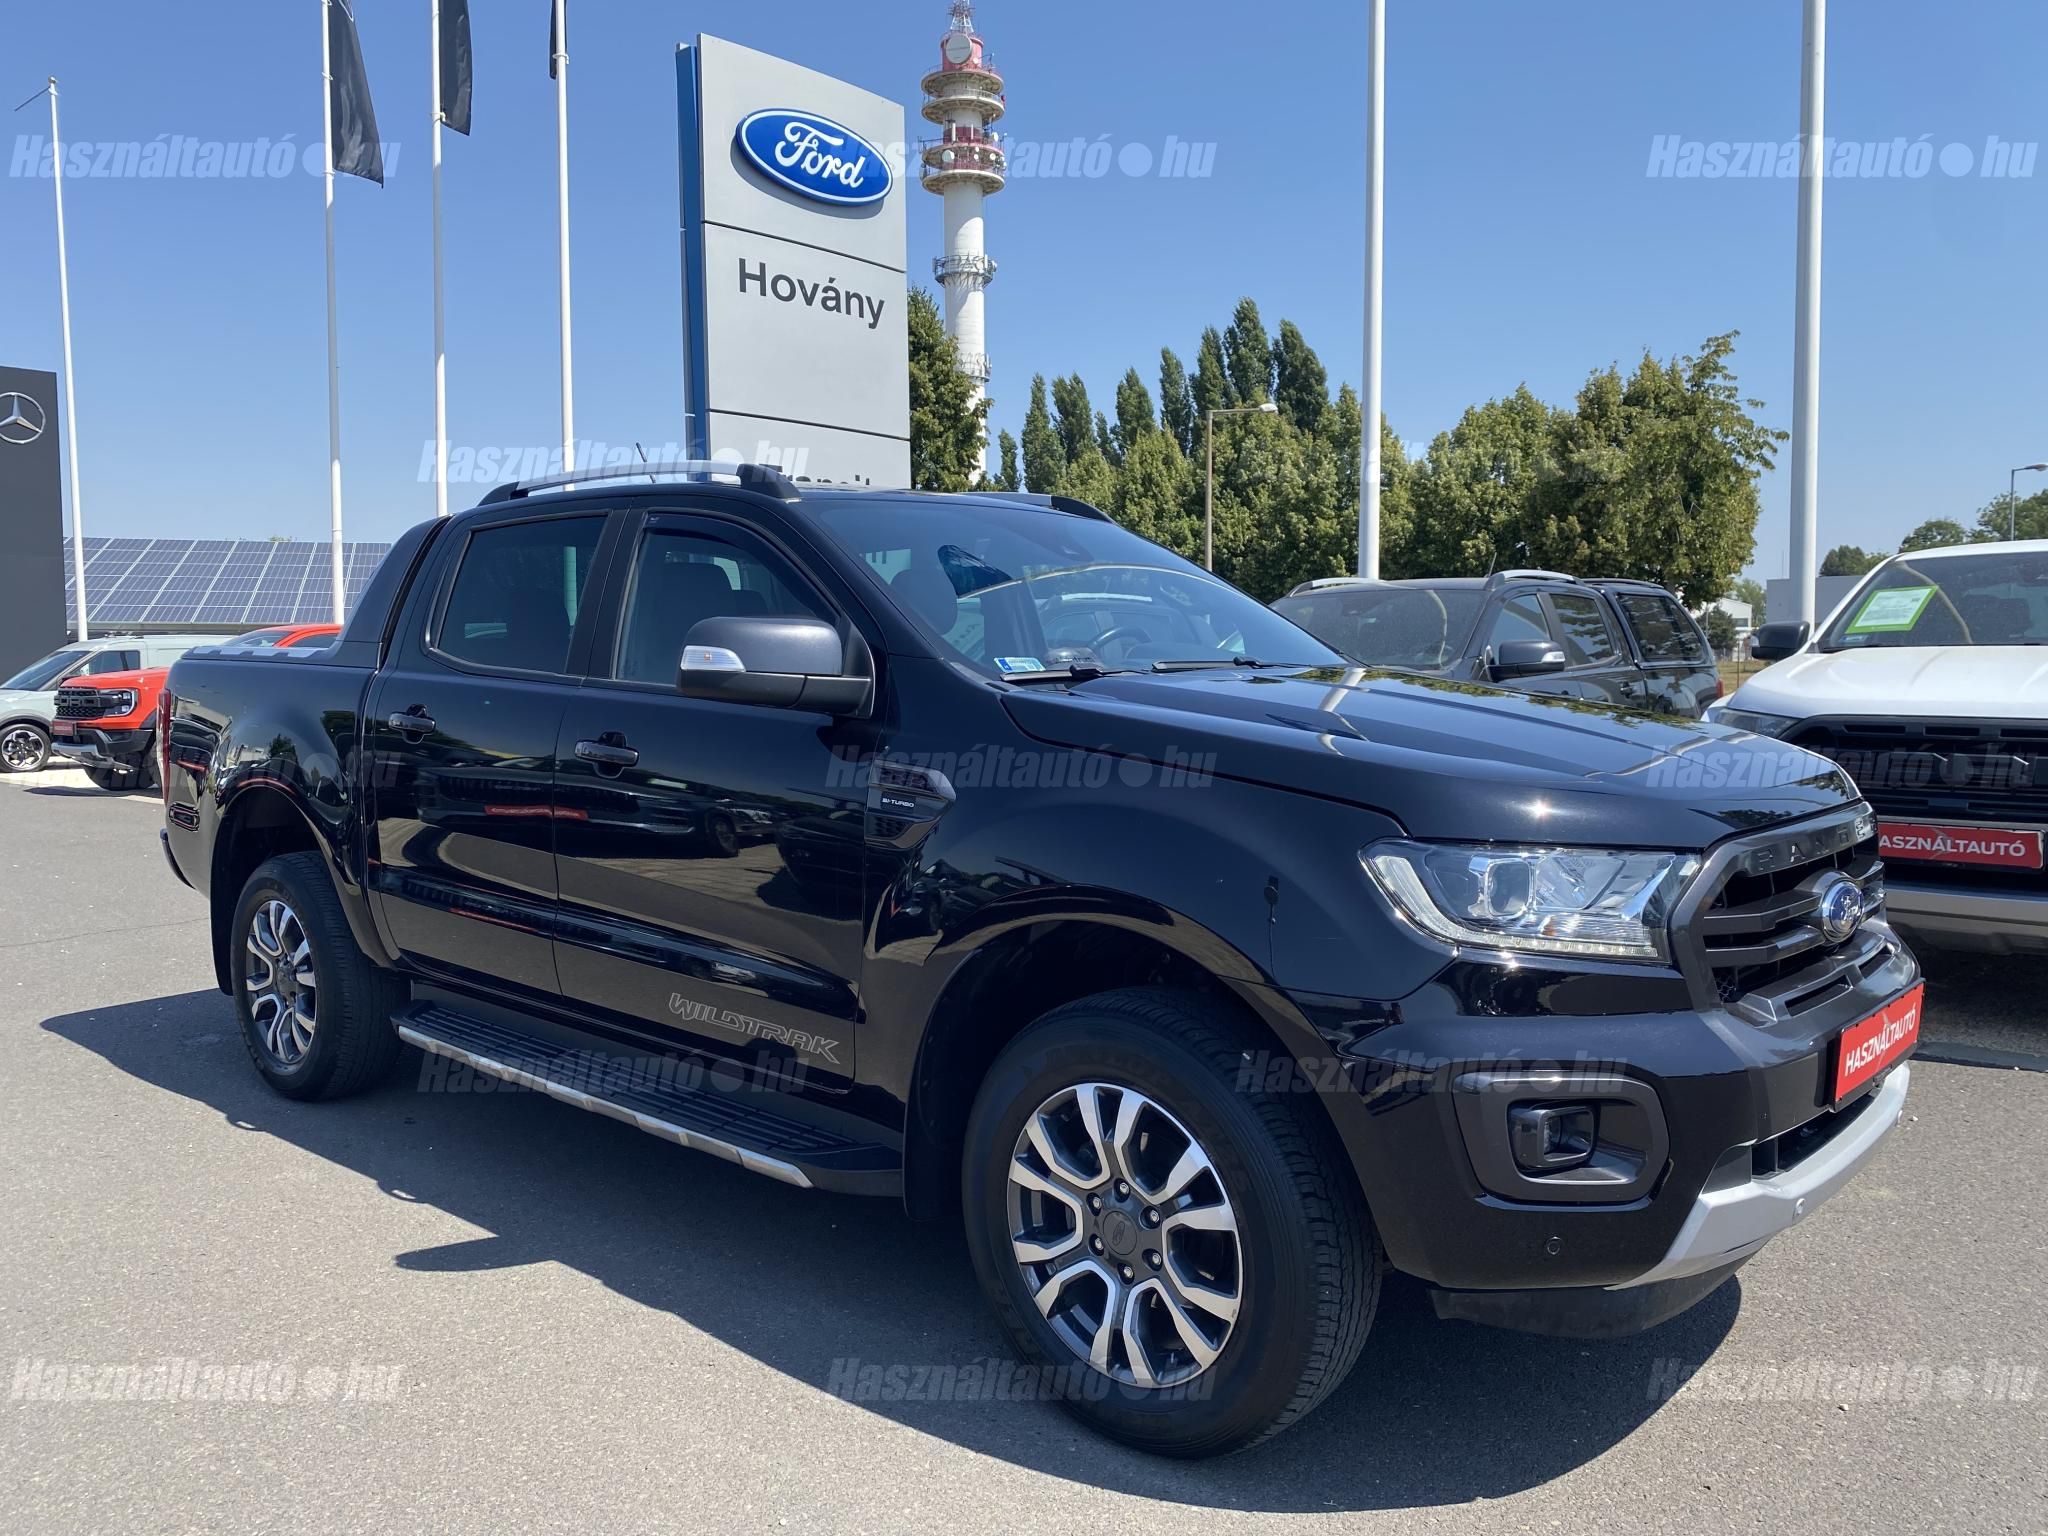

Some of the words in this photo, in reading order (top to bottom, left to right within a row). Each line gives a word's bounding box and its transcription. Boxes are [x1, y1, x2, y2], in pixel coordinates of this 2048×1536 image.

[775, 121, 864, 188] Ford
[739, 257, 885, 330] Hovány
[881, 797, 915, 808] BI-TURBO
[1879, 834, 2026, 857] ASZNÁLTAUTÓ
[669, 992, 841, 1065] WILDTRAK
[1844, 1002, 1917, 1077] HASZNÁLTAUTÓ
